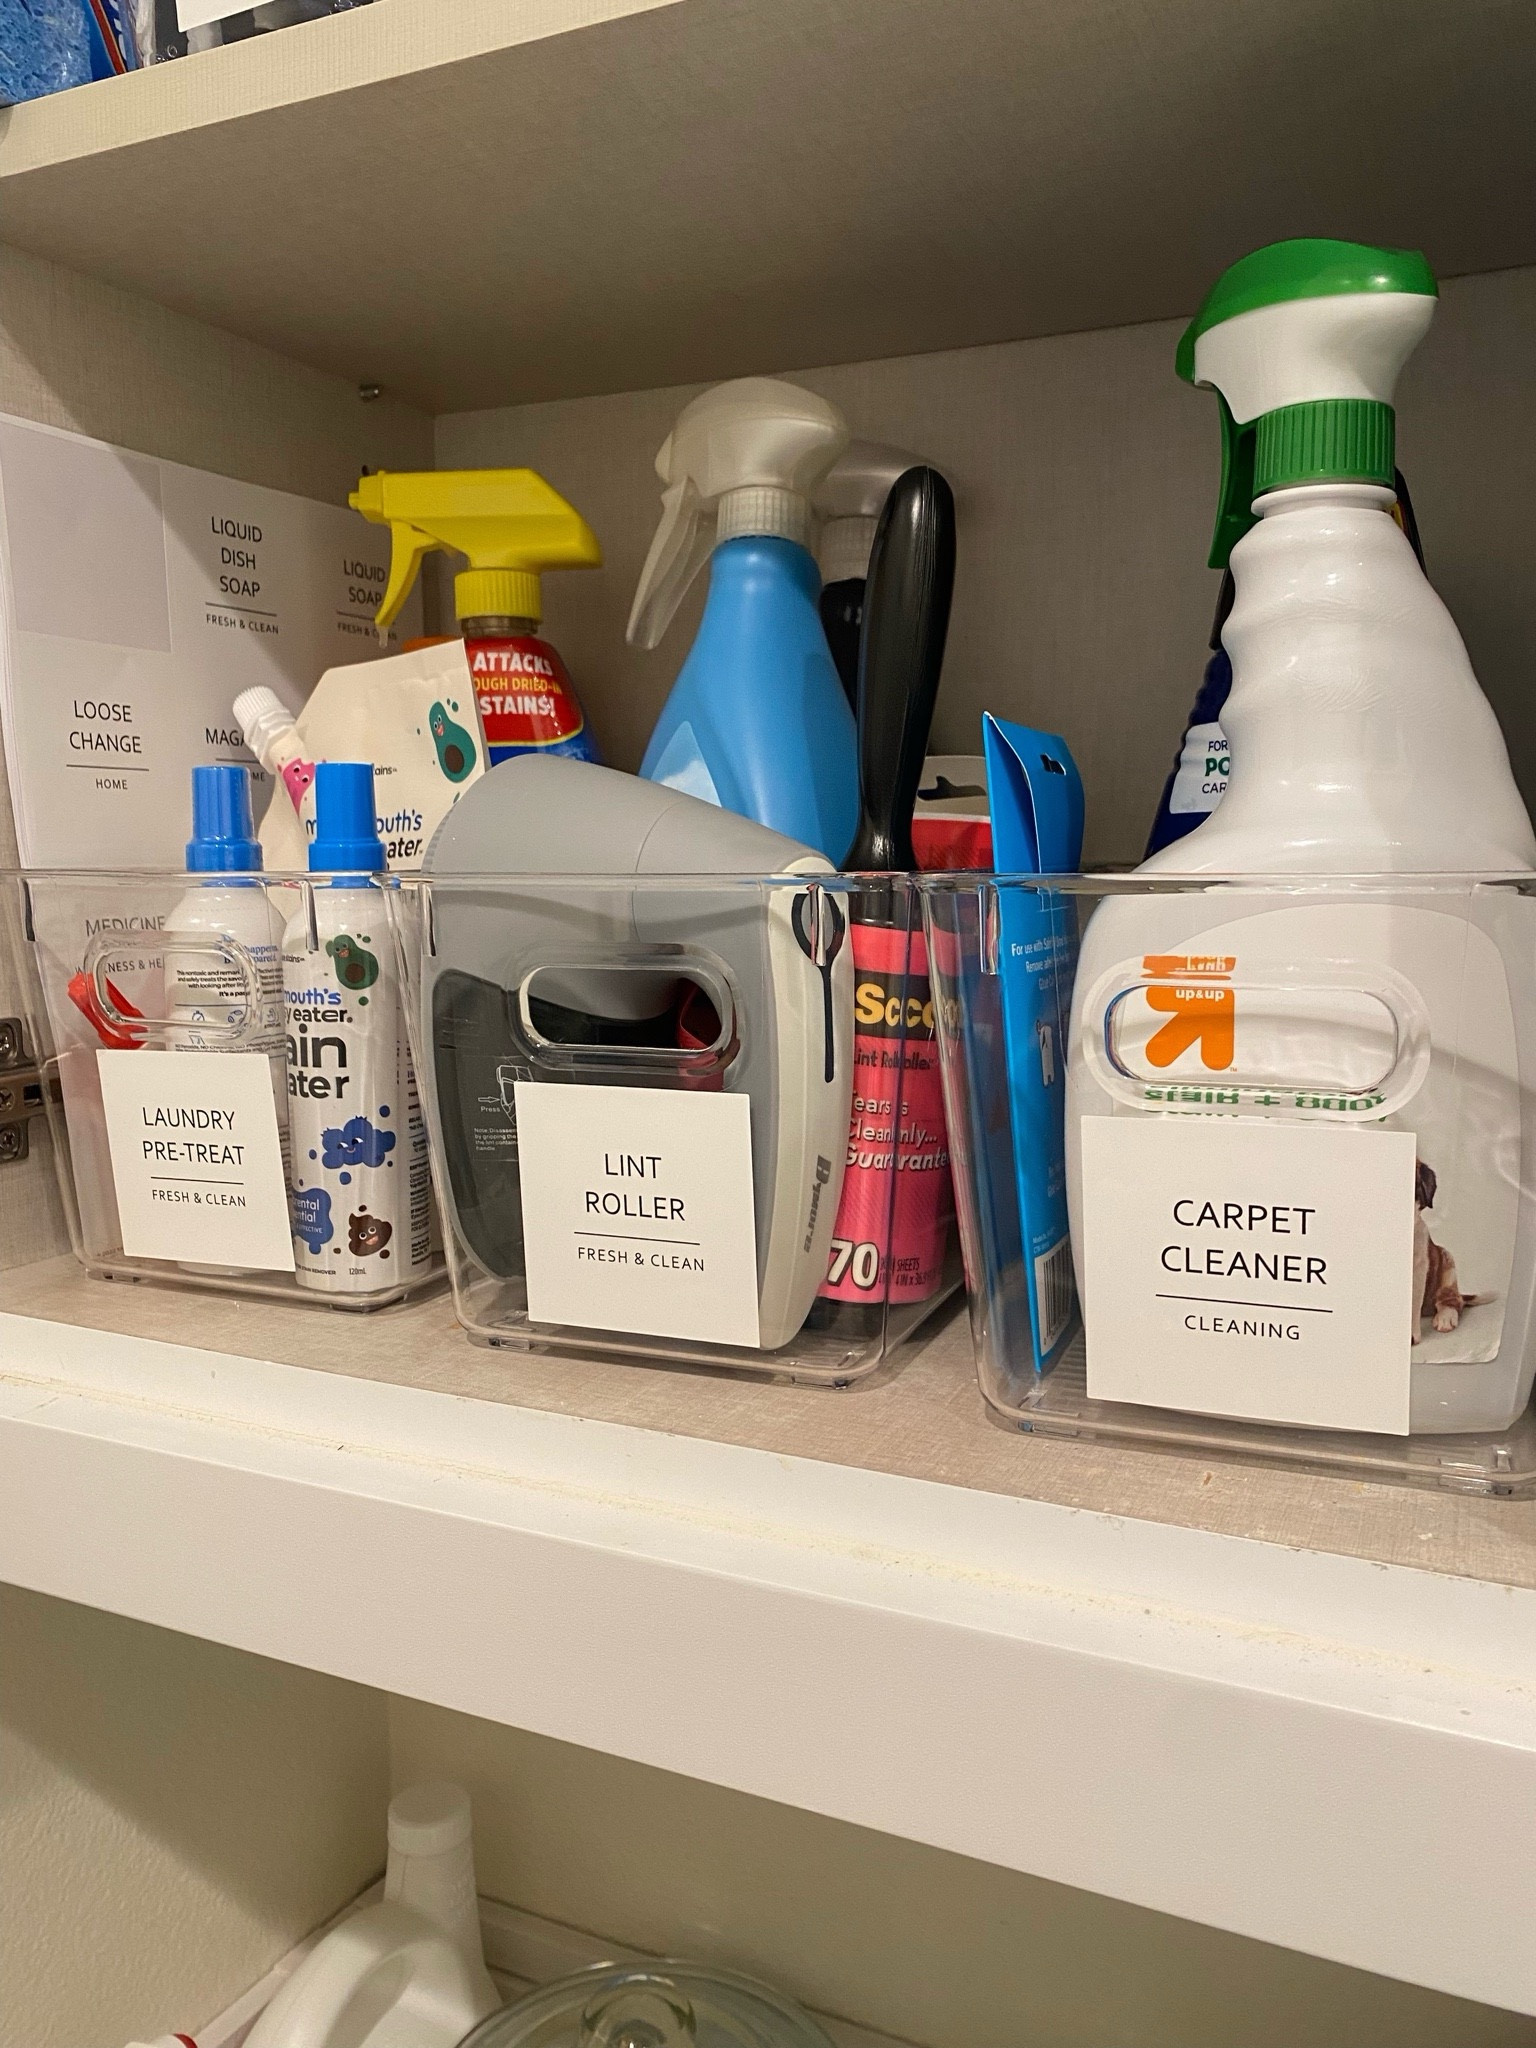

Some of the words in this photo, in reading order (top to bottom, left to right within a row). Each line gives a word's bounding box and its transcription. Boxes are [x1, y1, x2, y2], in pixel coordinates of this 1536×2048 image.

[211, 516, 263, 543] LIQUID
[221, 546, 257, 570] DISH
[343, 559, 386, 583] LIQUID
[219, 575, 261, 598] SOAP
[348, 586, 383, 606] SOAP
[206, 613, 237, 629] FRESH
[239, 619, 246, 630] &
[248, 620, 279, 634] CLEAN
[473, 651, 554, 677] ATTACKS
[473, 677, 508, 692] OUGH
[74, 699, 133, 723] LOOSE
[480, 695, 556, 717] STAINS!
[69, 731, 142, 754] CHANGE
[1207, 740, 1228, 753] FOR
[95, 778, 129, 791] HOME
[1011, 943, 1023, 957] For
[1175, 989, 1226, 1002] up&up
[142, 1106, 235, 1131] LAUNDRY
[142, 1140, 245, 1166] PRE-TREAT
[604, 1153, 662, 1179] LINT
[152, 1189, 190, 1204] FRESH
[194, 1192, 202, 1204] &
[205, 1193, 246, 1208] CLEAN
[585, 1190, 686, 1222] ROLLER
[1173, 1199, 1316, 1235] CARPET
[578, 1247, 629, 1264] FRESH
[634, 1252, 645, 1266] &
[650, 1254, 704, 1272] CLEAN
[827, 1237, 879, 1292] 70
[1161, 1245, 1327, 1285] CLEANER
[1184, 1315, 1300, 1340] CLEANING
